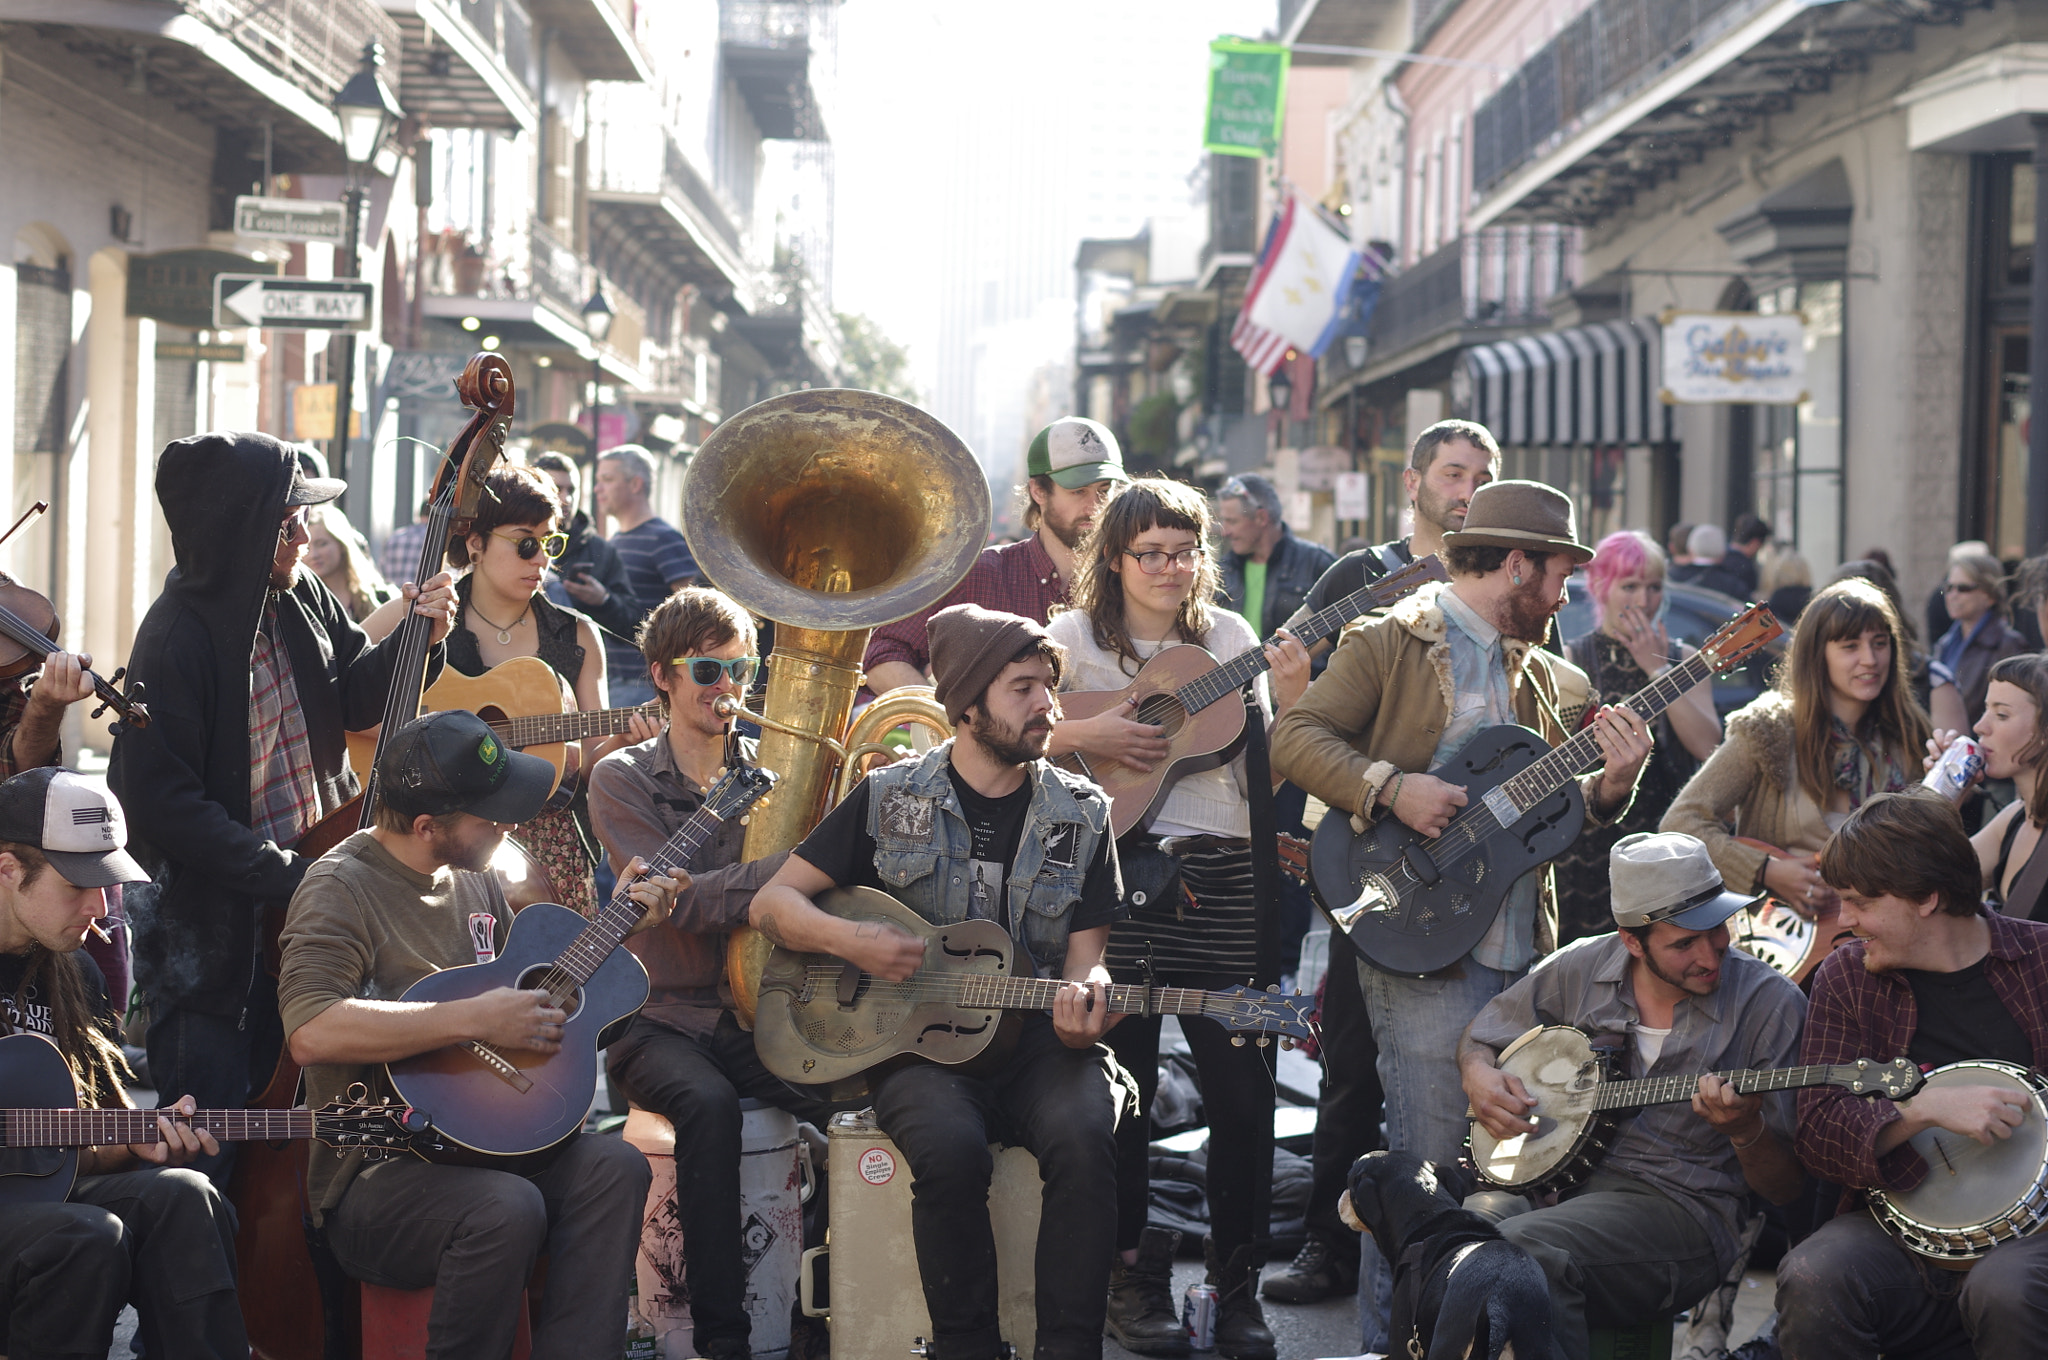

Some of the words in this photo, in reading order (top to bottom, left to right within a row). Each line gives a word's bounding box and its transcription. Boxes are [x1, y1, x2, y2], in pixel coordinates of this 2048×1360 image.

[242, 210, 338, 235] Toulouse
[264, 293, 304, 314] ONE
[313, 295, 358, 315] WAY
[1901, 1065, 1913, 1089] VEGA
[866, 1161, 888, 1170] Single
[868, 1154, 882, 1163] NO
[631, 1341, 652, 1351] Evan
